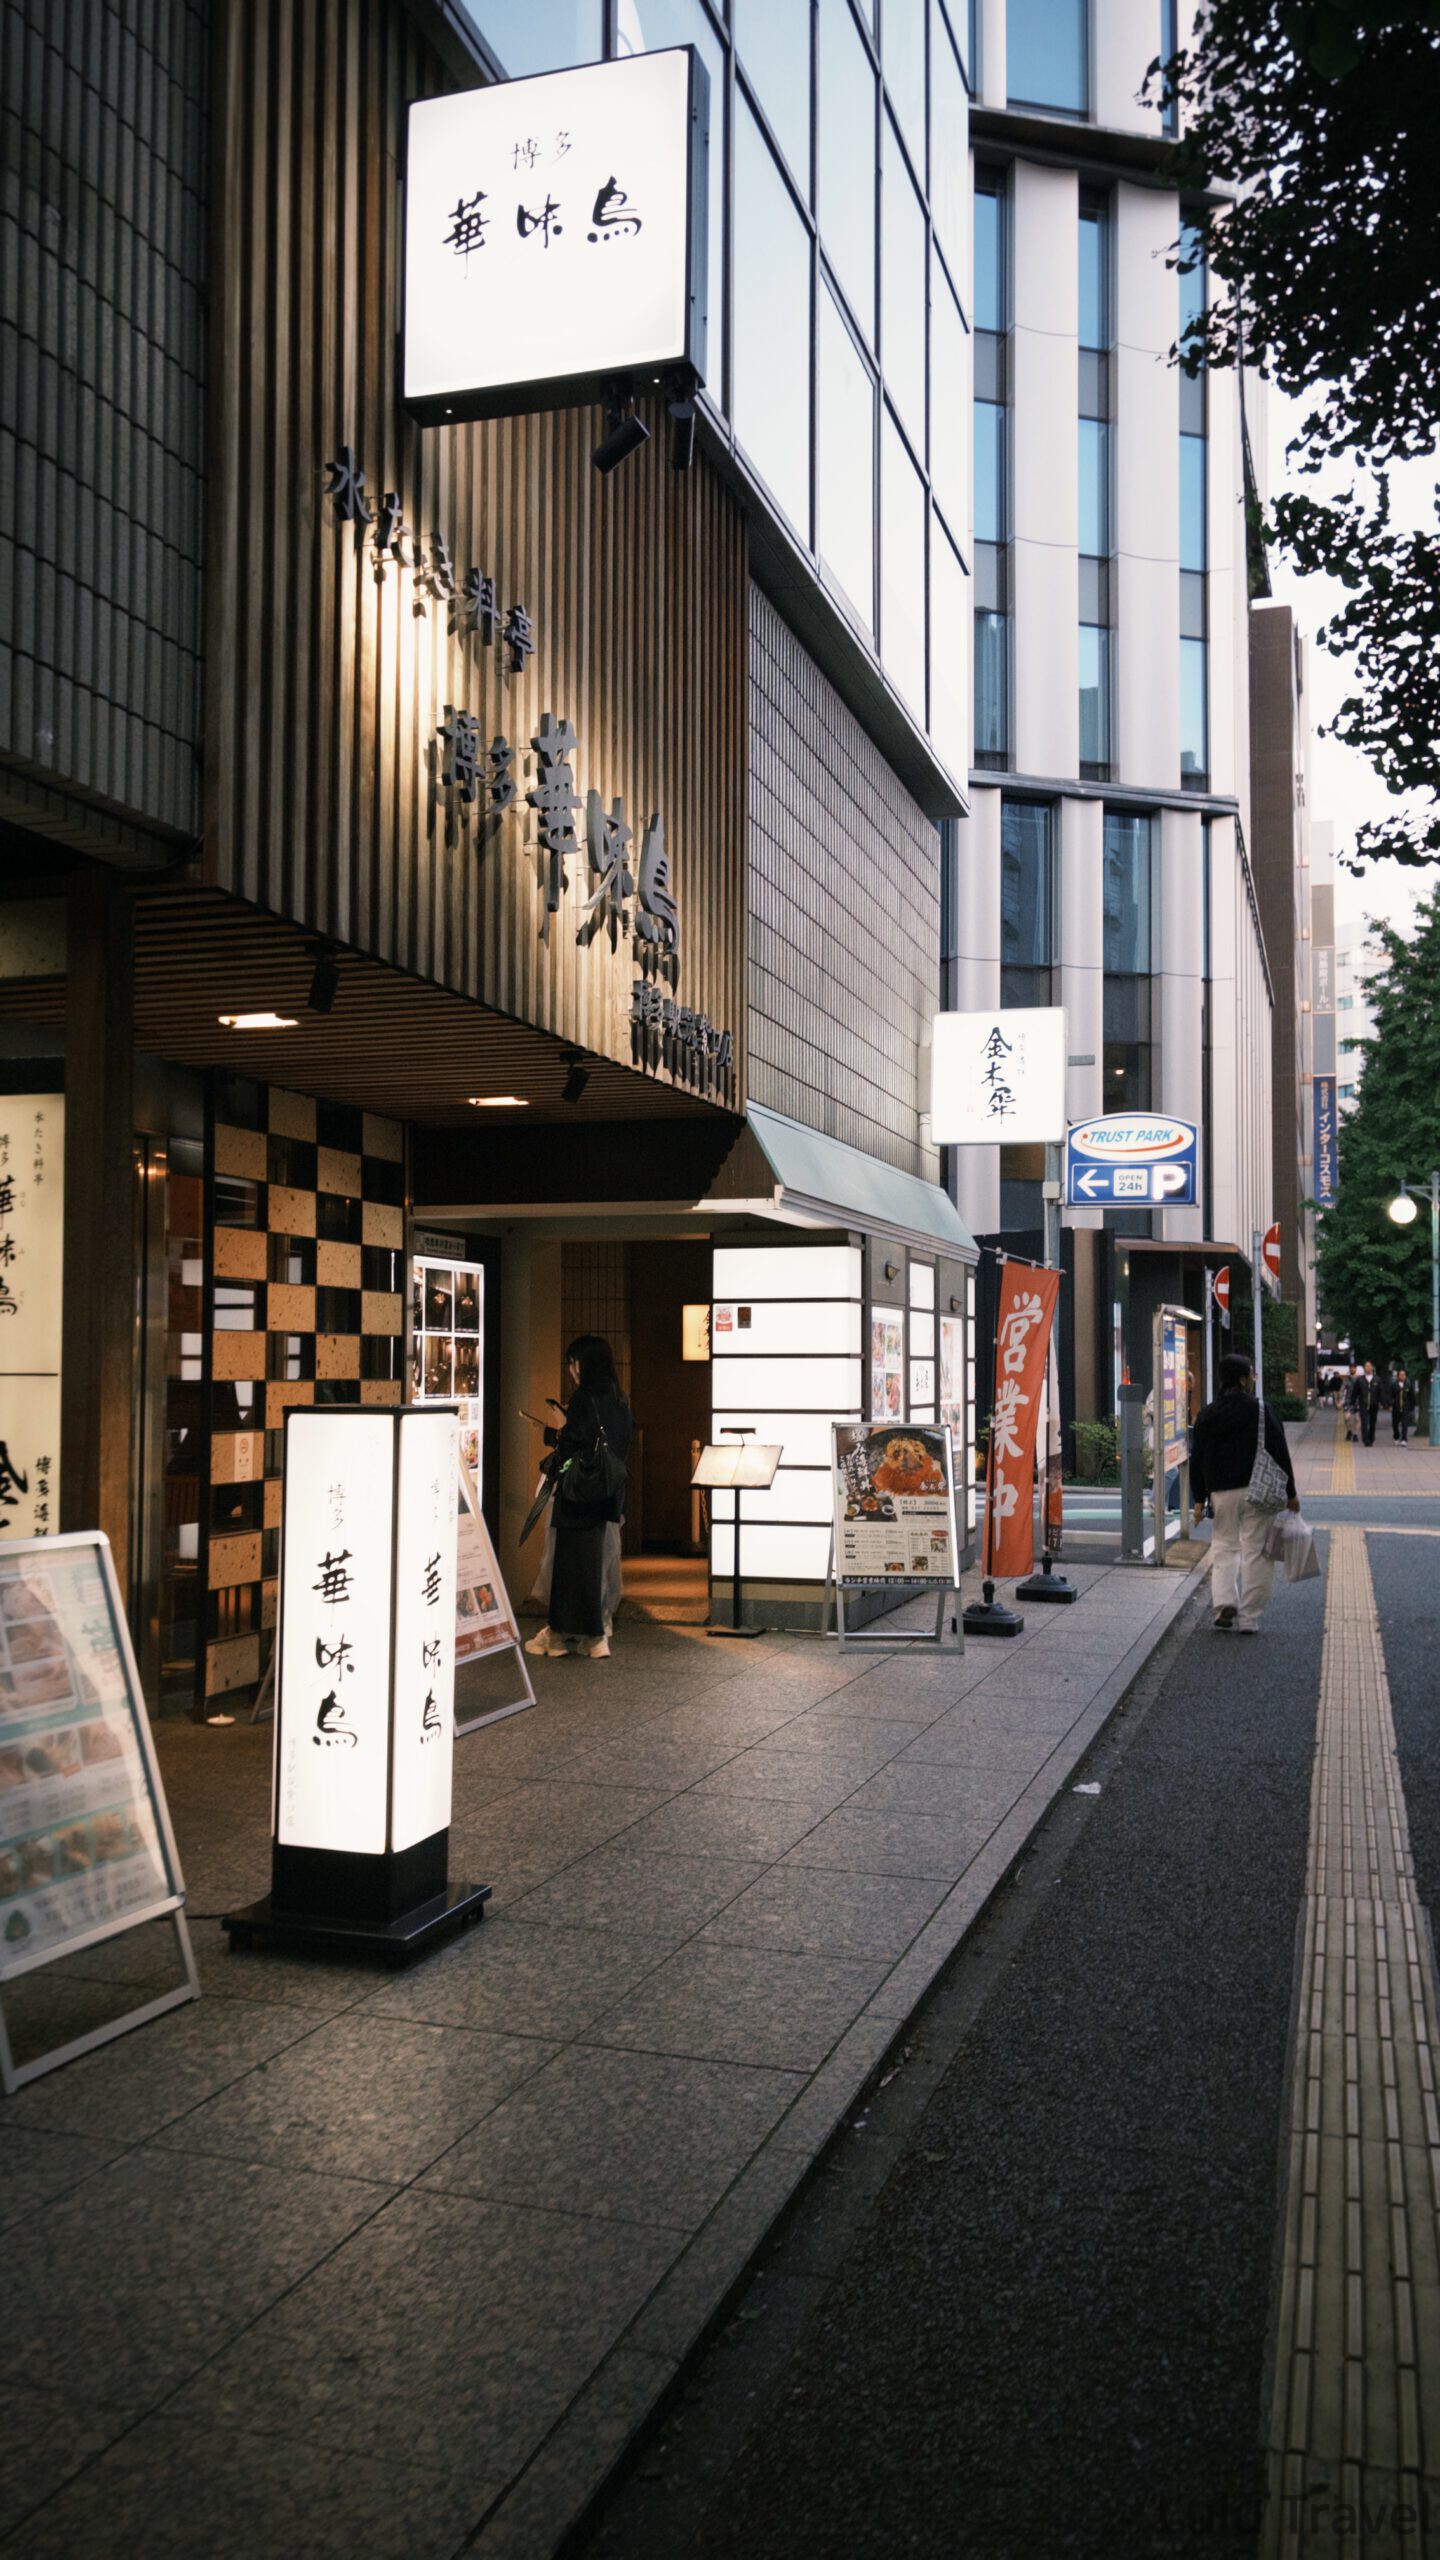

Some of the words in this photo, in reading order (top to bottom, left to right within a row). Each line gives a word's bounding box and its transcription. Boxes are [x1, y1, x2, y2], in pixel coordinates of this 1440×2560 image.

[510, 130, 573, 171] 博多
[325, 446, 535, 673] 水たき料亭
[1089, 1129, 1135, 1144] TRUST
[1135, 1128, 1174, 1142] PARK
[1118, 1174, 1143, 1182] OPEN
[1118, 1181, 1143, 1192] 24h
[993, 1291, 1044, 1553] 営業中
